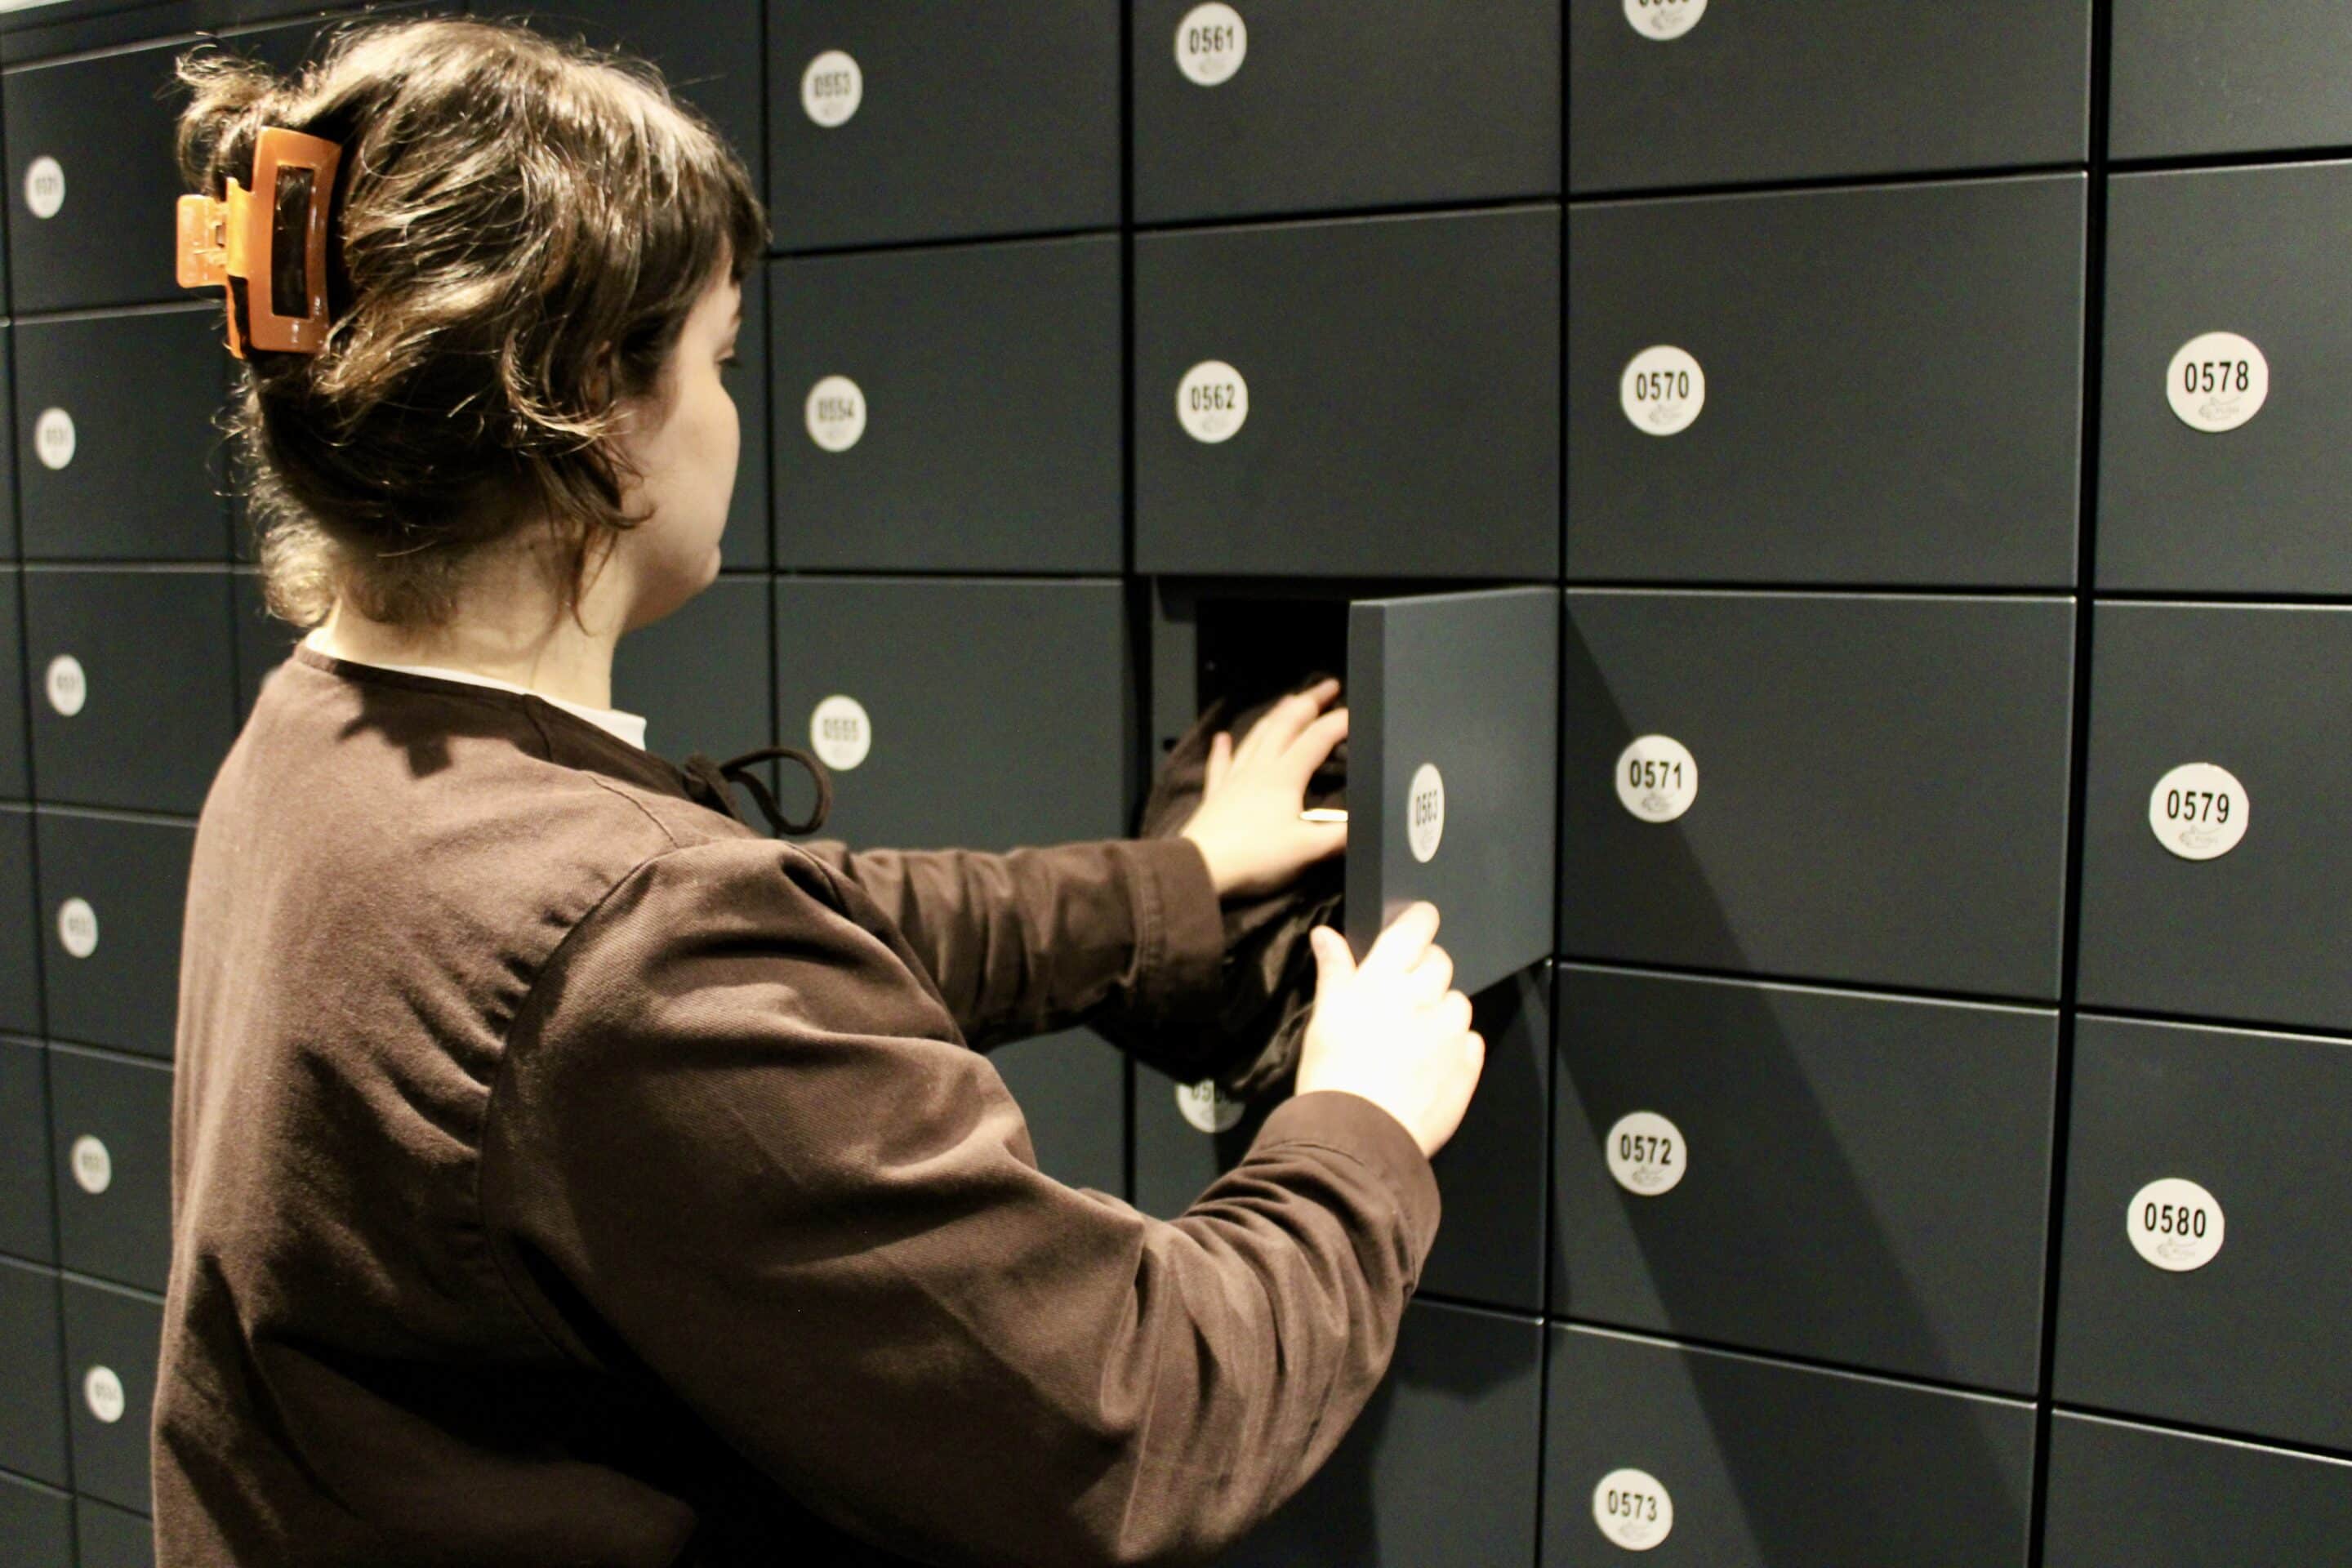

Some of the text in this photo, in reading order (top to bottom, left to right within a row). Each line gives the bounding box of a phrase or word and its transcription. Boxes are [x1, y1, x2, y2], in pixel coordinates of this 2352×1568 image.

[1189, 25, 1233, 55] 0561
[1636, 370, 1689, 401] 0570
[2184, 360, 2249, 394] 0578
[817, 398, 854, 422] 0554
[1191, 384, 1234, 412] 0562
[1629, 759, 1681, 789] 0571
[1416, 790, 1438, 826] 0563
[2167, 789, 2230, 824] 0579
[1619, 1134, 1672, 1165] 0572
[2144, 1202, 2207, 1239] 0580
[1608, 1489, 1657, 1522] 0573
